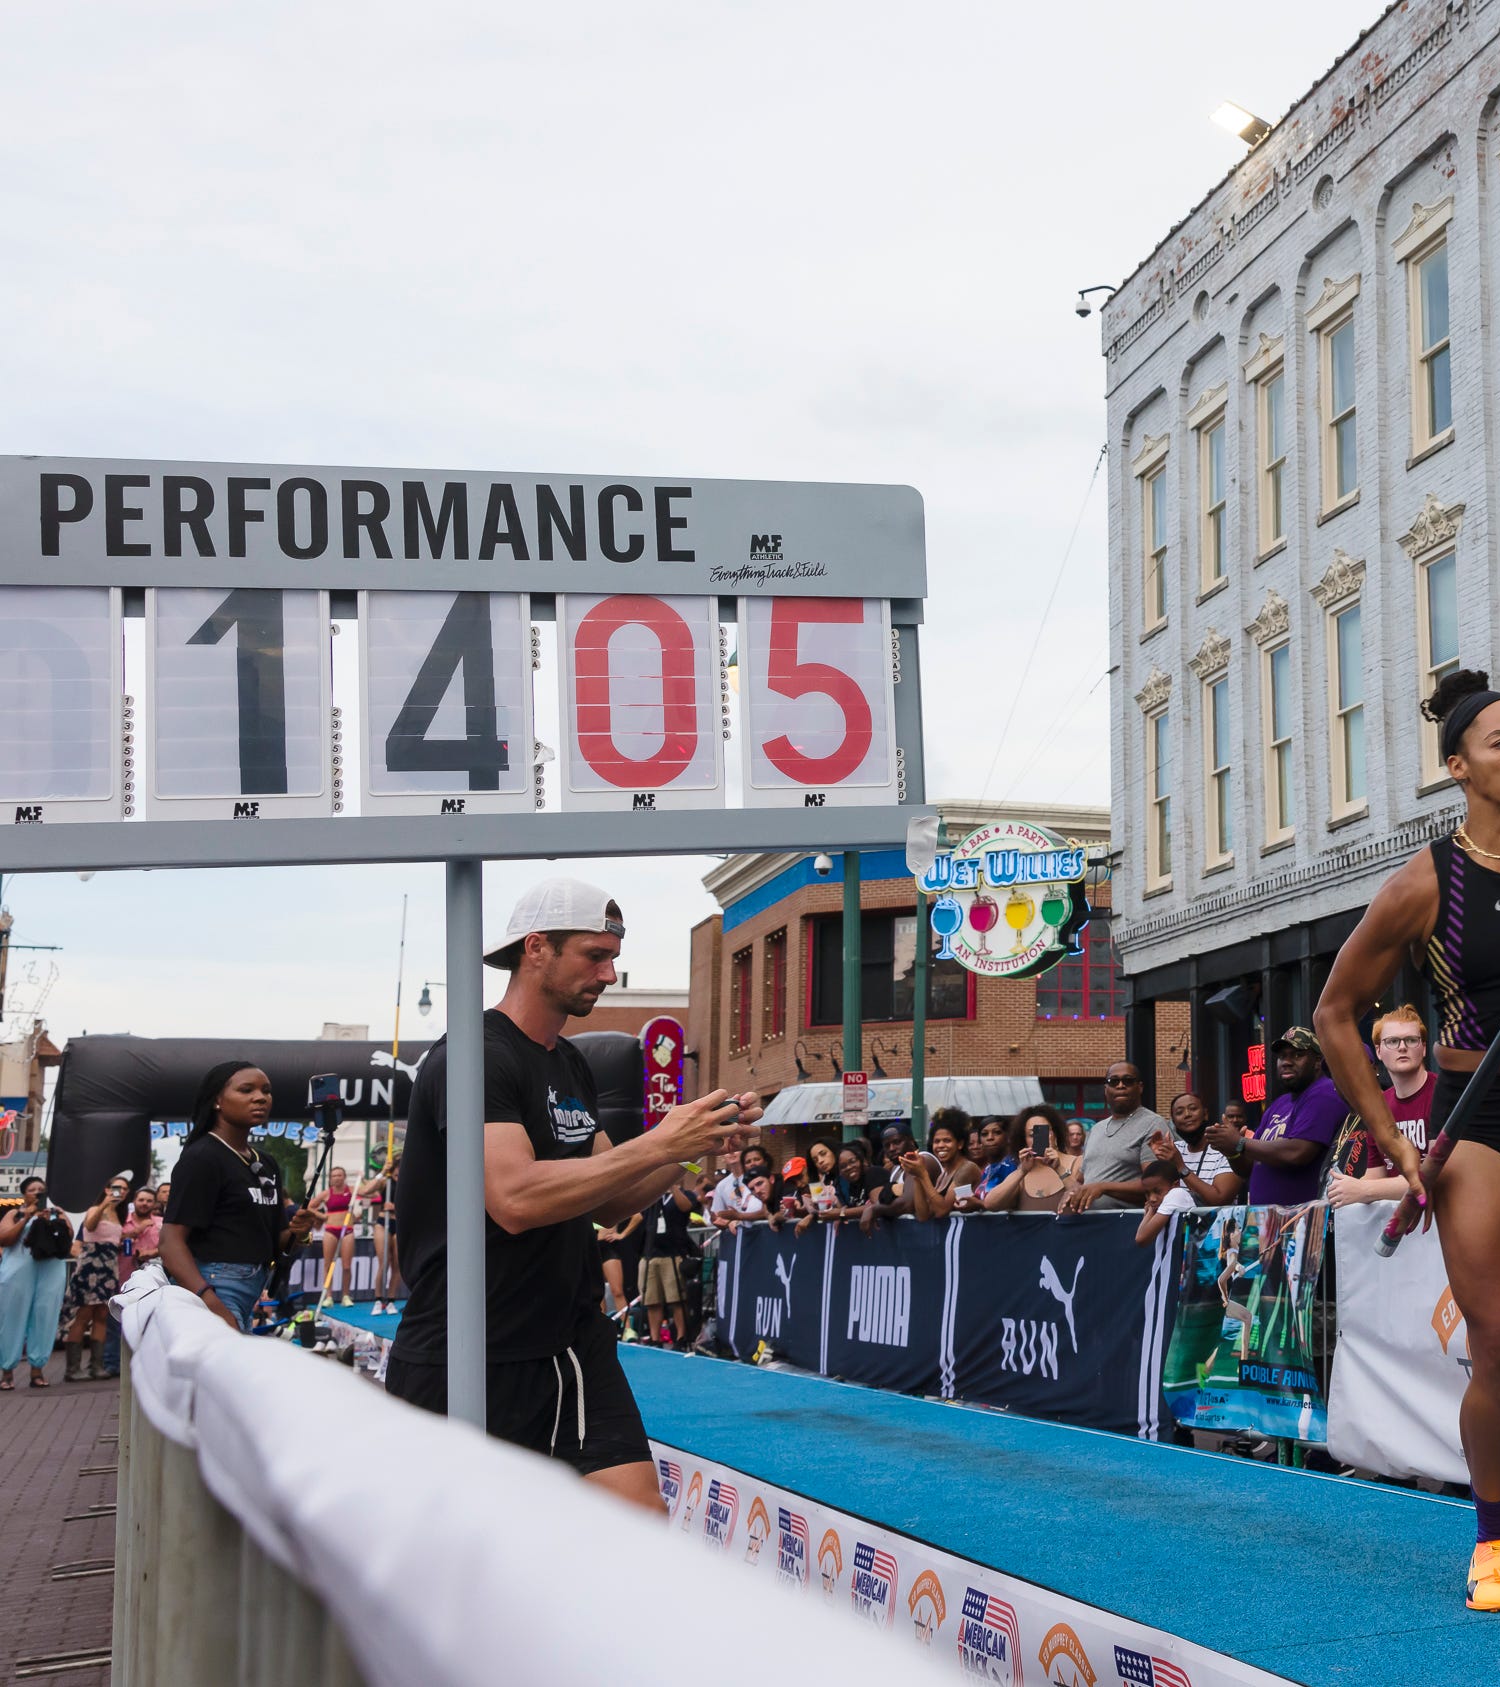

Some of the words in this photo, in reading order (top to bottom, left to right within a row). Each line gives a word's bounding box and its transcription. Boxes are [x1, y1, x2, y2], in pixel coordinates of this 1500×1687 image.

[40, 473, 695, 563] PERFORMANCE
[185, 588, 287, 794] 1
[386, 591, 509, 791] 4
[574, 595, 698, 787] 0
[762, 597, 872, 785] 5
[961, 847, 969, 857] A
[969, 831, 991, 848] BAR
[1006, 825, 1014, 834] A
[1018, 826, 1049, 849] PARTY
[923, 855, 981, 890] WET
[956, 944, 970, 960] AN
[975, 939, 1046, 972] INSTITUTION
[651, 1073, 677, 1093] Tin
[848, 1074, 863, 1084] NO
[1396, 1119, 1426, 1150] TRO
[755, 1295, 782, 1339] RUN
[847, 1264, 911, 1348] PUMA
[1441, 1299, 1456, 1330] ED
[1001, 1318, 1059, 1380] RUN
[852, 1569, 888, 1605] AMERICAN
[958, 1618, 1006, 1661] AMERICAN
[1069, 1634, 1091, 1680] CLASSIC
[957, 1643, 988, 1681] TRACK
